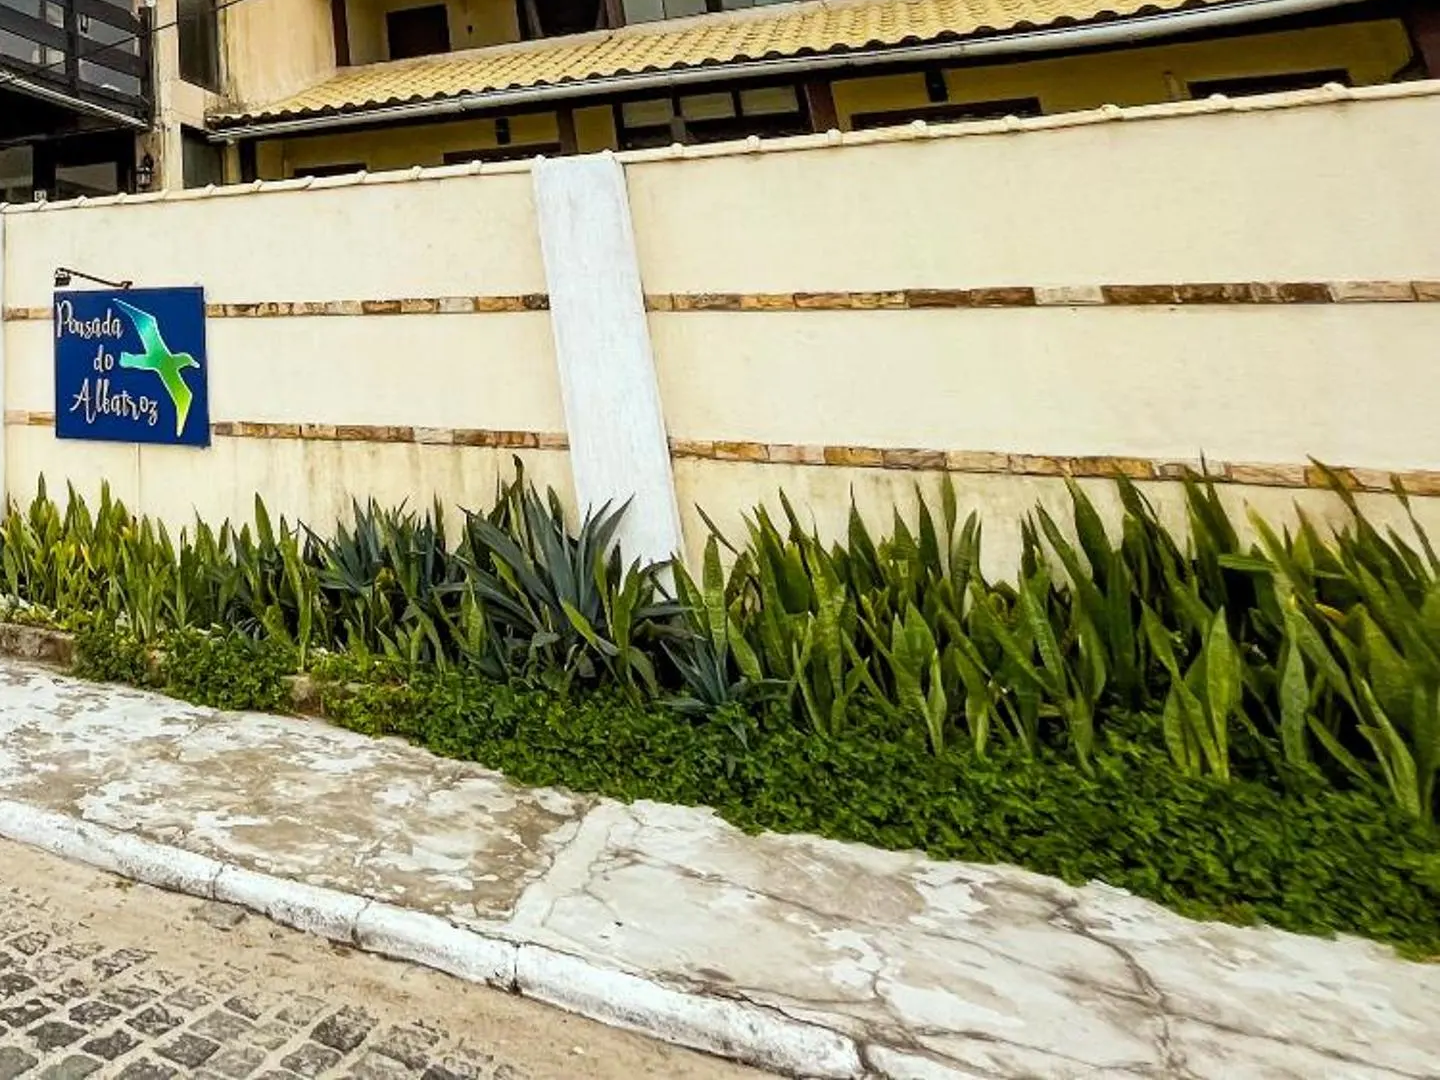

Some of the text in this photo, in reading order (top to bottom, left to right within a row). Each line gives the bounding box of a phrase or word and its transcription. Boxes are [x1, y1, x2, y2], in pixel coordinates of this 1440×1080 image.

[56, 300, 124, 339] Pousada
[93, 344, 115, 373] do
[69, 377, 159, 426] Albatroz
